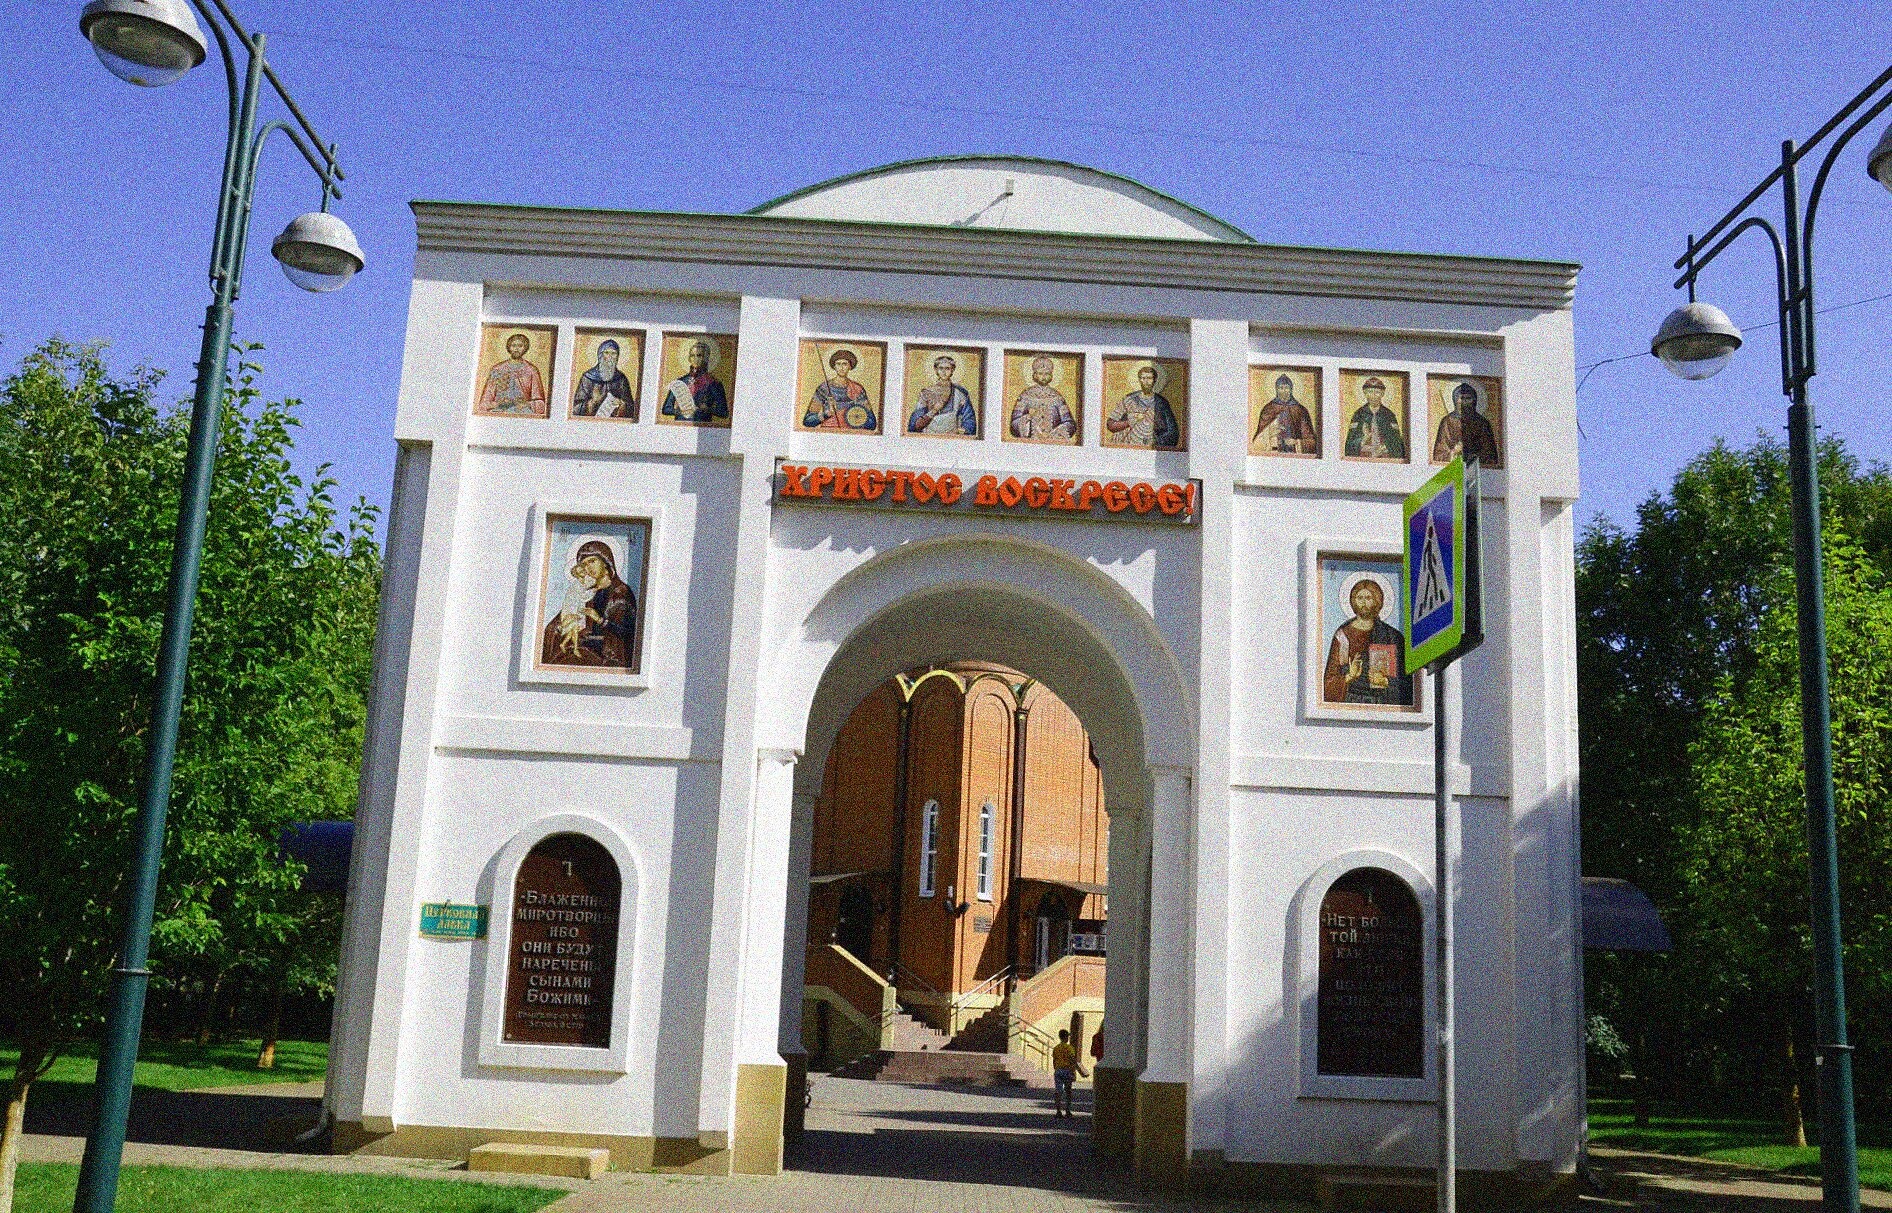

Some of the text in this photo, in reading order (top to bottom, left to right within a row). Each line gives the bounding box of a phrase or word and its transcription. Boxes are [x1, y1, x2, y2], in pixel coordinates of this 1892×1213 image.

[779, 464, 1197, 517] ХРИСТОС ВОСКРЕСЕ!
[549, 926, 580, 938] ИБО
[1330, 928, 1358, 943] ТОЙ
[522, 941, 552, 954] ОНИ
[529, 975, 592, 989] СЫНАМИ
